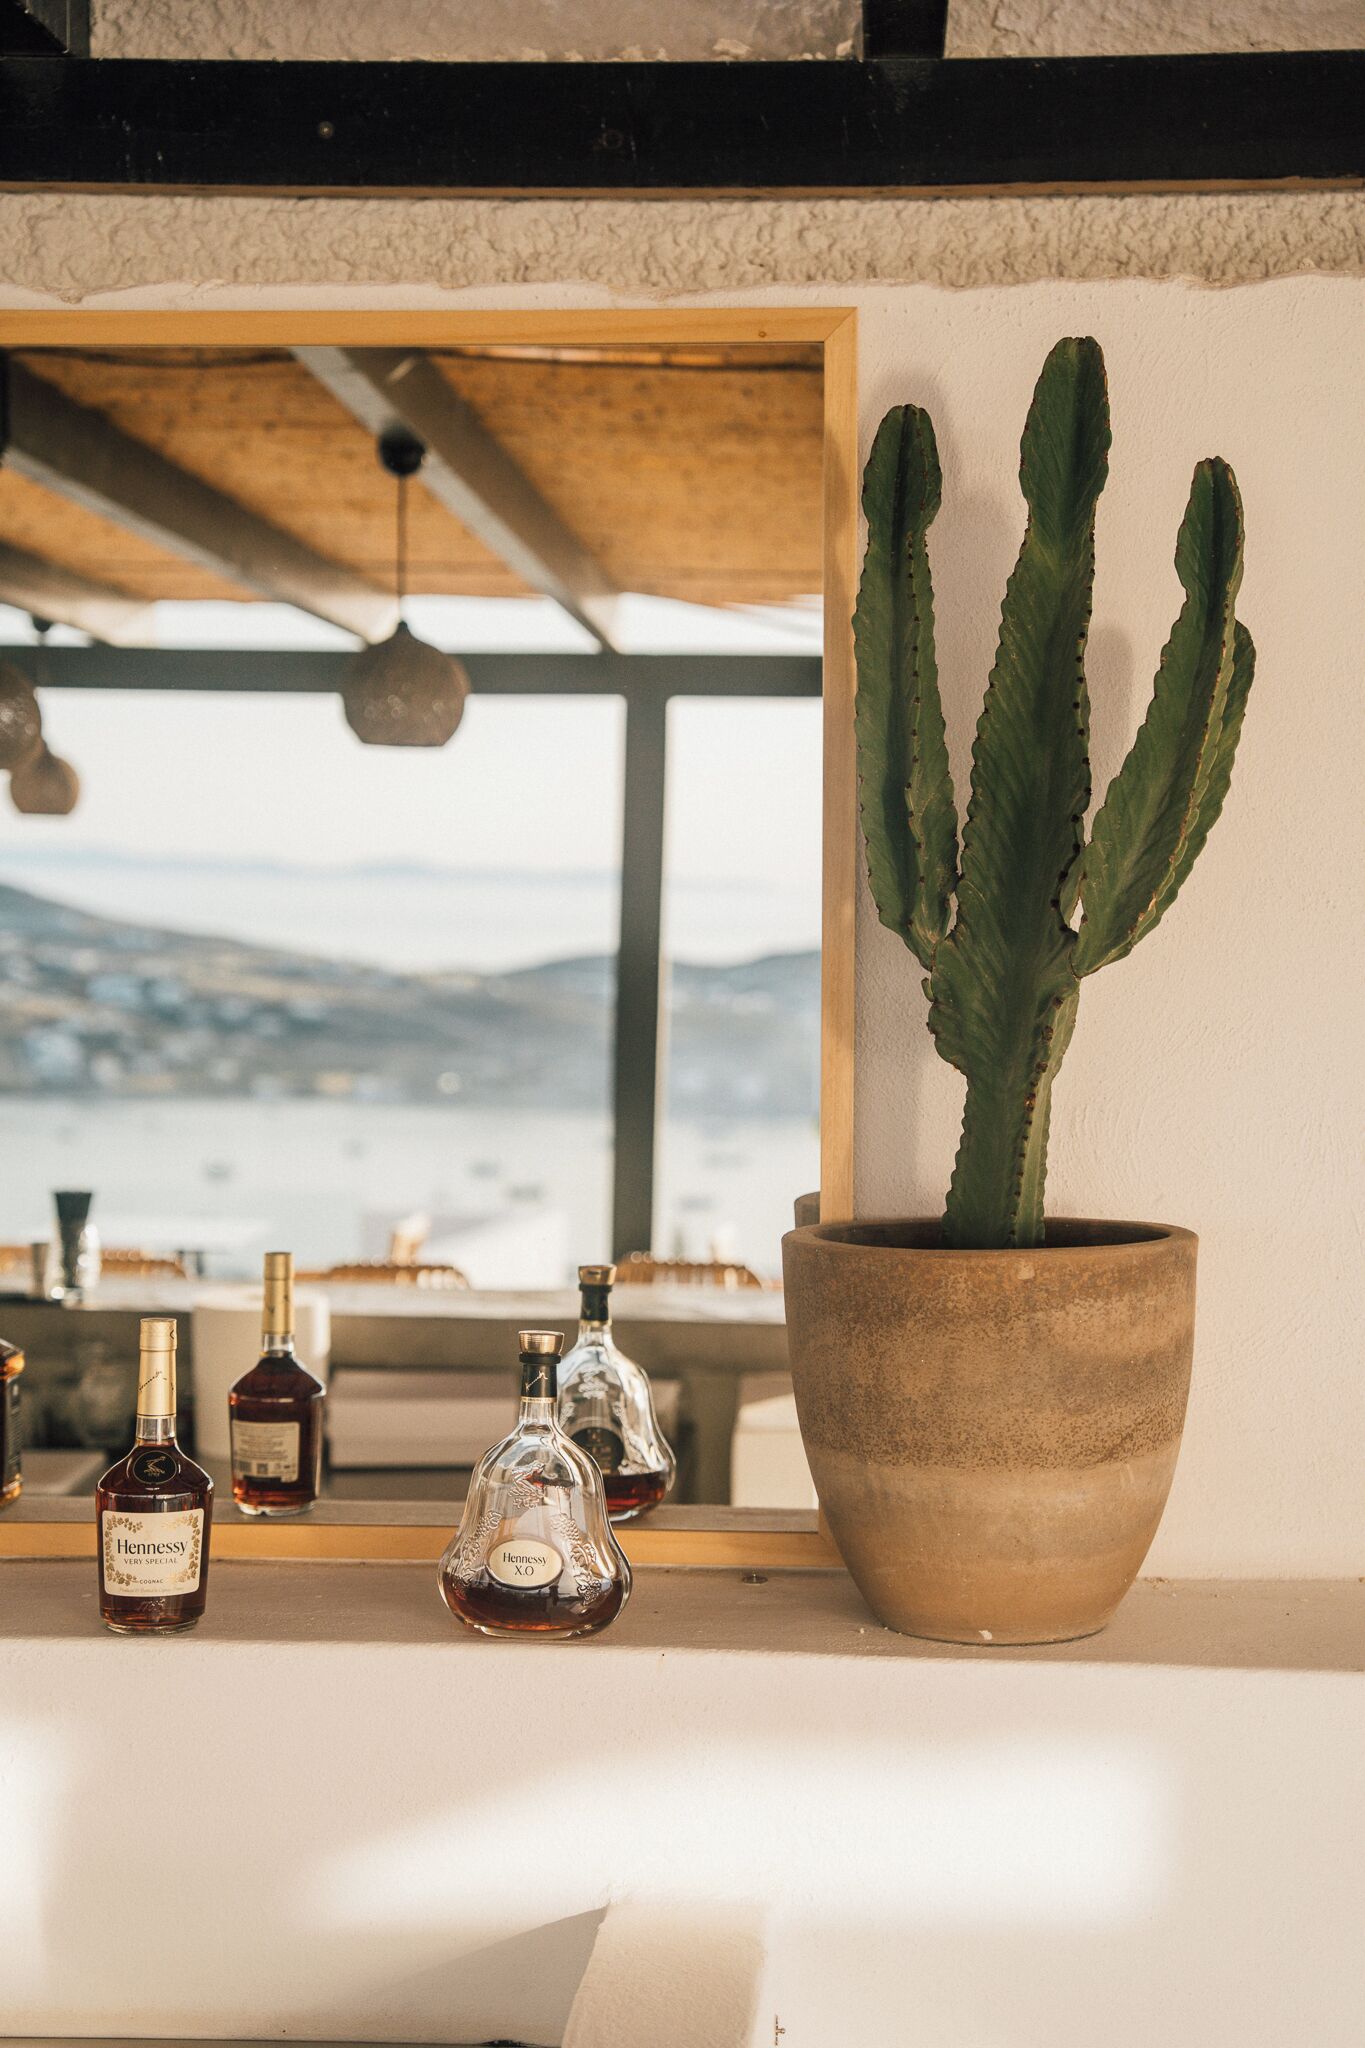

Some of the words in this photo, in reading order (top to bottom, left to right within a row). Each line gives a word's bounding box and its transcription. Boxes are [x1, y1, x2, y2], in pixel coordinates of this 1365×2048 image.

[117, 1538, 188, 1556] Hennessy
[145, 1557, 178, 1565] SPECIAL
[503, 1552, 547, 1567] Hennessy
